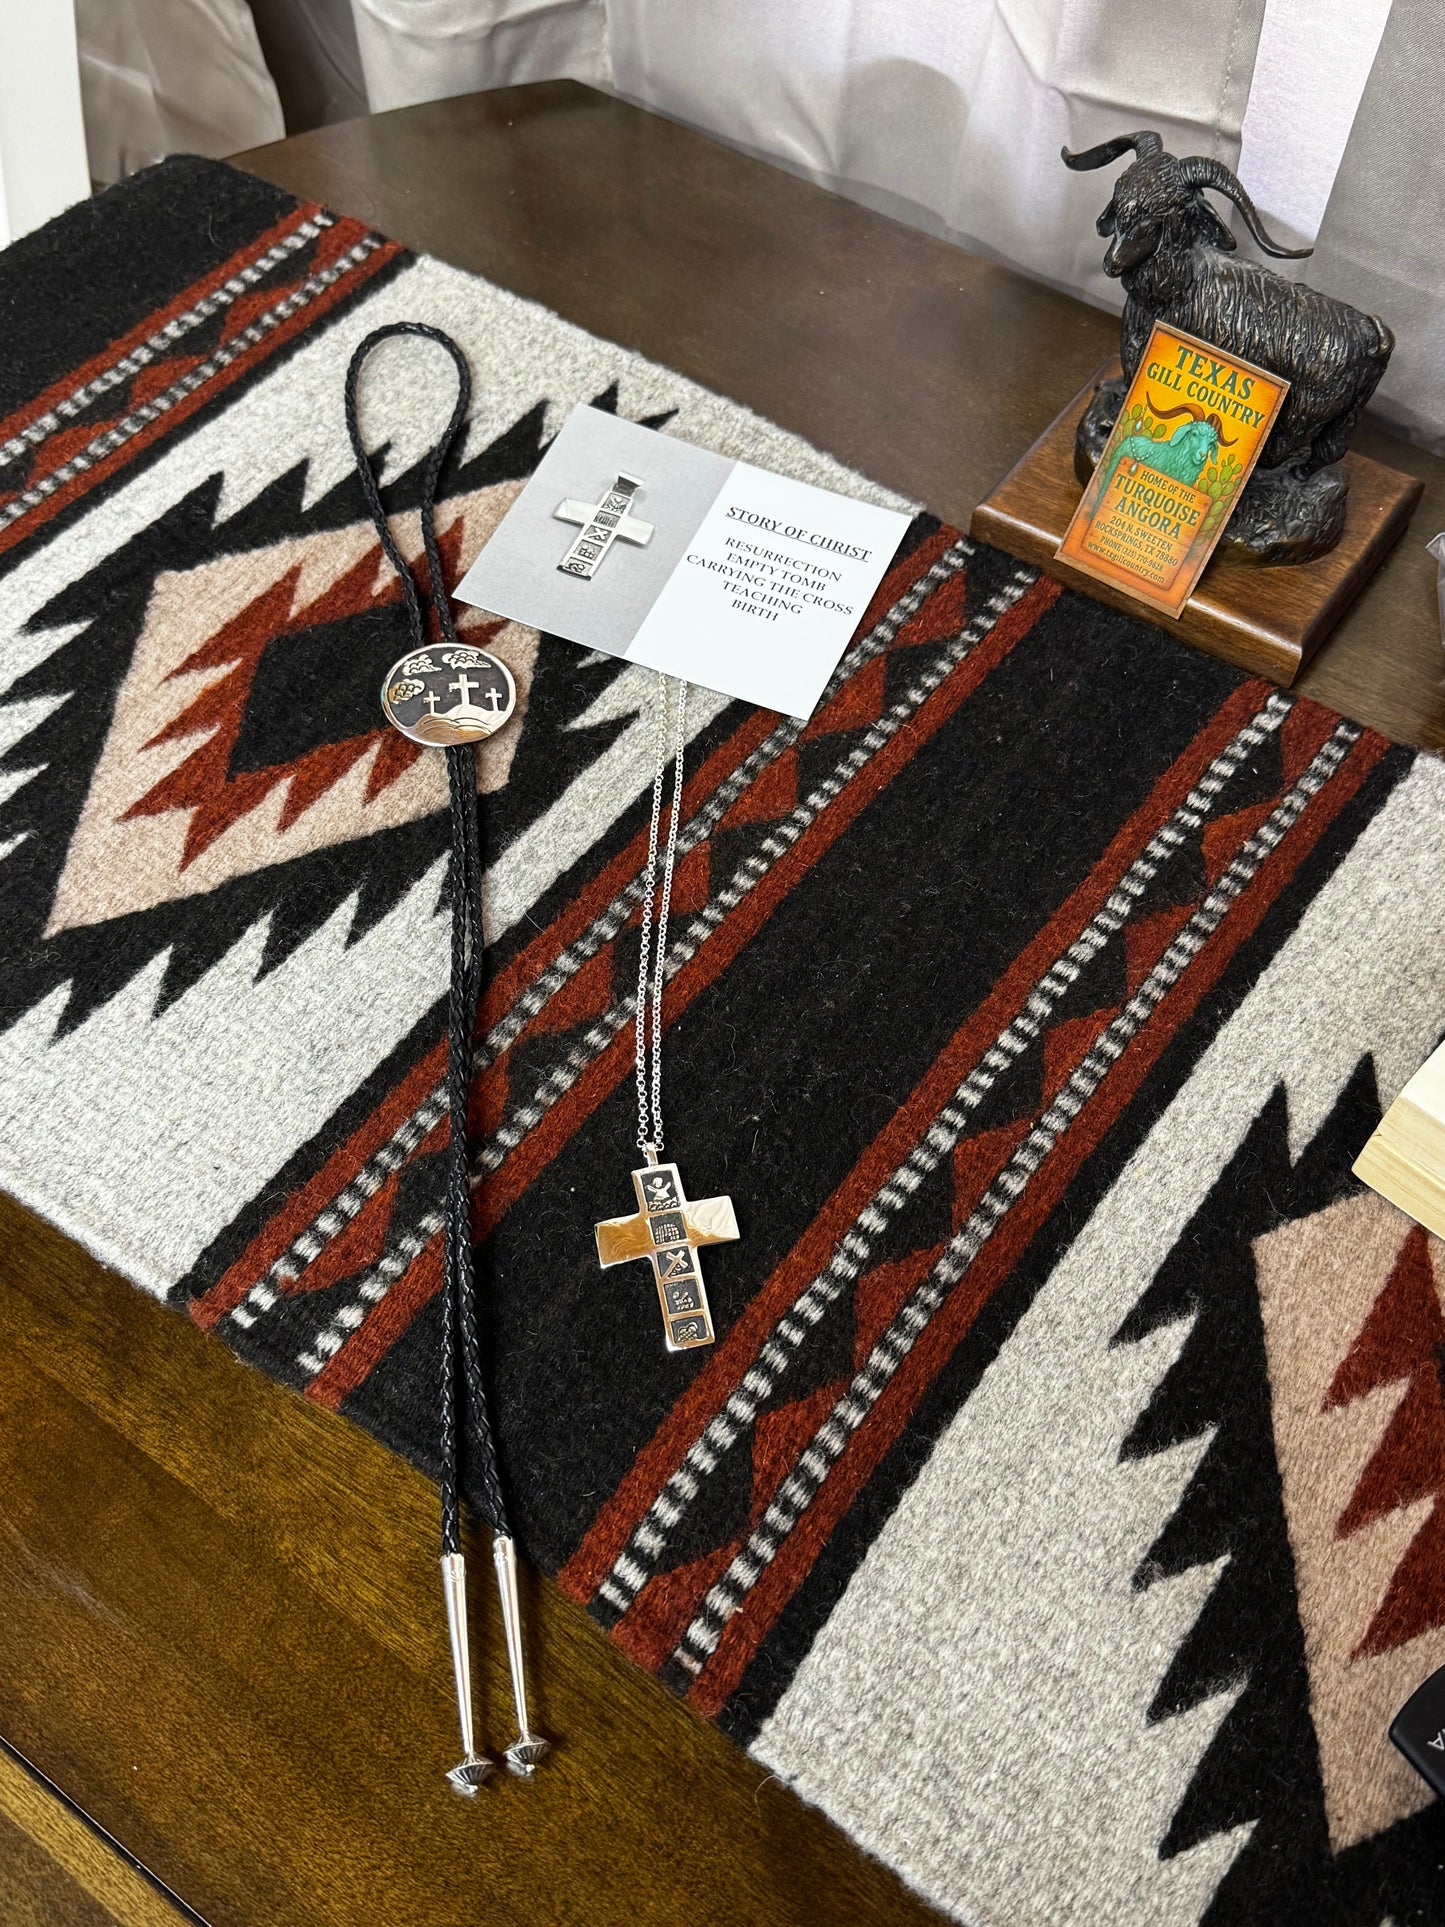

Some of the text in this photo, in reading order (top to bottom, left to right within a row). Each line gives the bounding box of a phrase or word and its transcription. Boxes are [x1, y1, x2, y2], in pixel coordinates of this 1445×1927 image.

[1175, 345, 1255, 400] TEXAS
[1147, 362, 1265, 429] GILL COUNTRY
[1114, 473, 1200, 526] TURQUOISE
[1140, 470, 1196, 504] HOME OF THE
[727, 506, 872, 561] STORY OF CHRIST
[1110, 516, 1173, 552] 204 N. SWEETEN
[1114, 496, 1181, 540] ANGORA
[725, 537, 843, 582] RESURRECTION
[1087, 541, 1165, 584] www.txgillcountry.com
[1095, 520, 1178, 567] ROCKSPRINGS, TX 78880
[1100, 536, 1123, 552] PHONE
[686, 554, 854, 616] CARRYING THE CROSS
[726, 552, 827, 592] EMPTY TOMB
[722, 580, 803, 614] TEACHING
[731, 599, 779, 622] BIRTH
